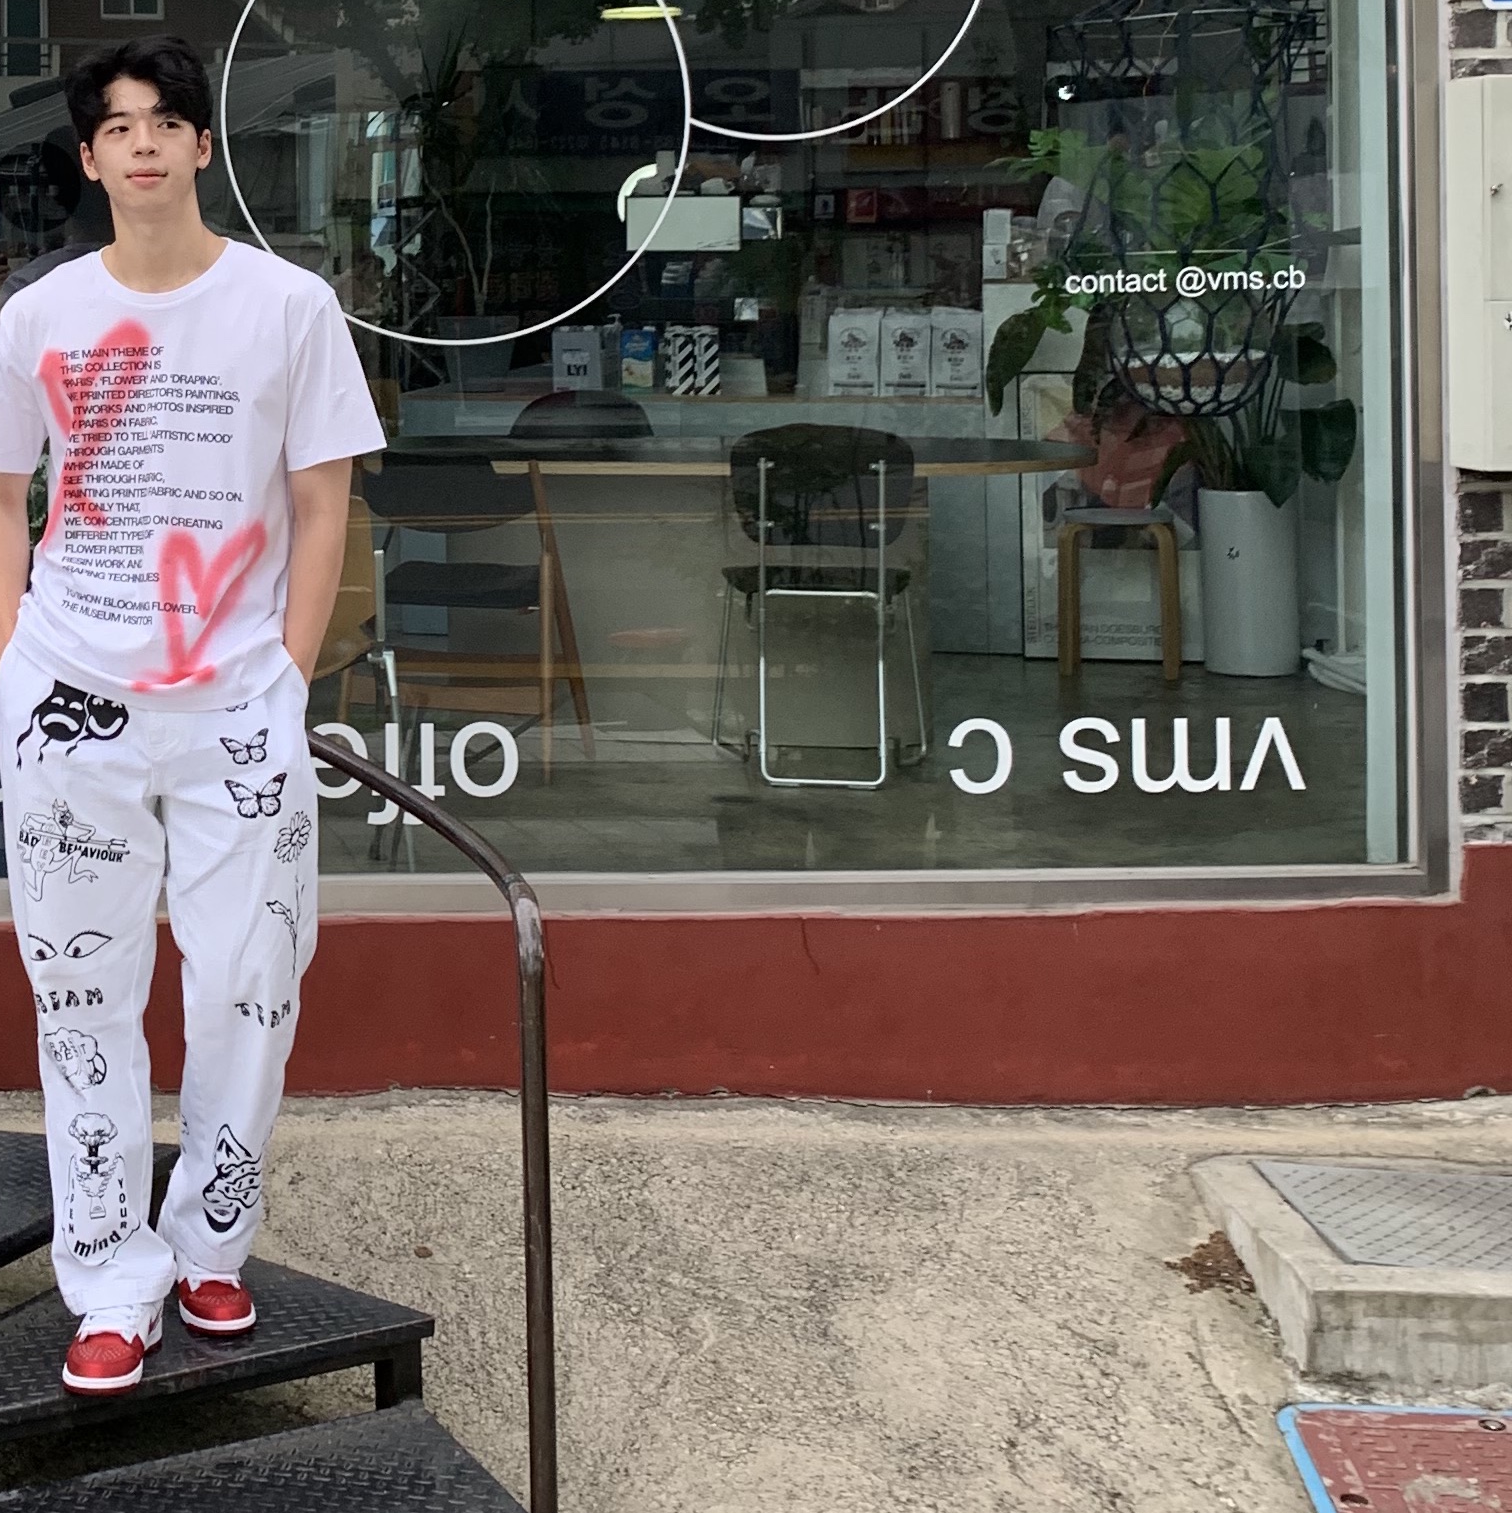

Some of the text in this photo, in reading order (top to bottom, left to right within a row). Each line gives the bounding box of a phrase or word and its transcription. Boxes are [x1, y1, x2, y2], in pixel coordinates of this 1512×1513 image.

[1064, 264, 1307, 298] contact @vms.cb
[59, 346, 165, 361] THE MAIN THEME OF
[60, 360, 162, 375] THIS COLLECTION IS
[150, 374, 168, 384] AND
[80, 389, 126, 401] PRINTED
[128, 388, 183, 399] DIRECTOR'S
[185, 389, 241, 402] PAINTINGS,
[124, 404, 146, 414] AND
[148, 402, 184, 413] PHOTOS
[186, 403, 234, 415] INSPIRED
[78, 418, 109, 429] PARIS
[110, 418, 127, 428] ON
[82, 432, 113, 442] TRIED
[114, 432, 129, 442] TO
[131, 431, 148, 441] TELL
[66, 444, 165, 457] THROUGH GARMENTS
[64, 459, 145, 471] WHICH MADE OF
[63, 475, 83, 485] SEE
[85, 474, 136, 484] THROUGH
[64, 488, 110, 499] PAINTING
[148, 487, 182, 498] FABRIC
[183, 489, 207, 500] AND
[209, 491, 224, 501] SO
[64, 502, 87, 513] NOT
[88, 502, 115, 512] ONLY
[64, 517, 82, 526] WE
[153, 515, 169, 525] ON
[170, 516, 223, 529] CREATING
[65, 530, 119, 541] DIFFERENT
[65, 544, 107, 555] FLOWER
[95, 559, 125, 569] WORK
[61, 599, 153, 626] THE MUSEUM VISITOR
[1057, 716, 1307, 794] vms
[19, 830, 40, 848] BAD
[59, 841, 124, 863] BEHAVIOUR
[73, 1230, 122, 1258] mind
